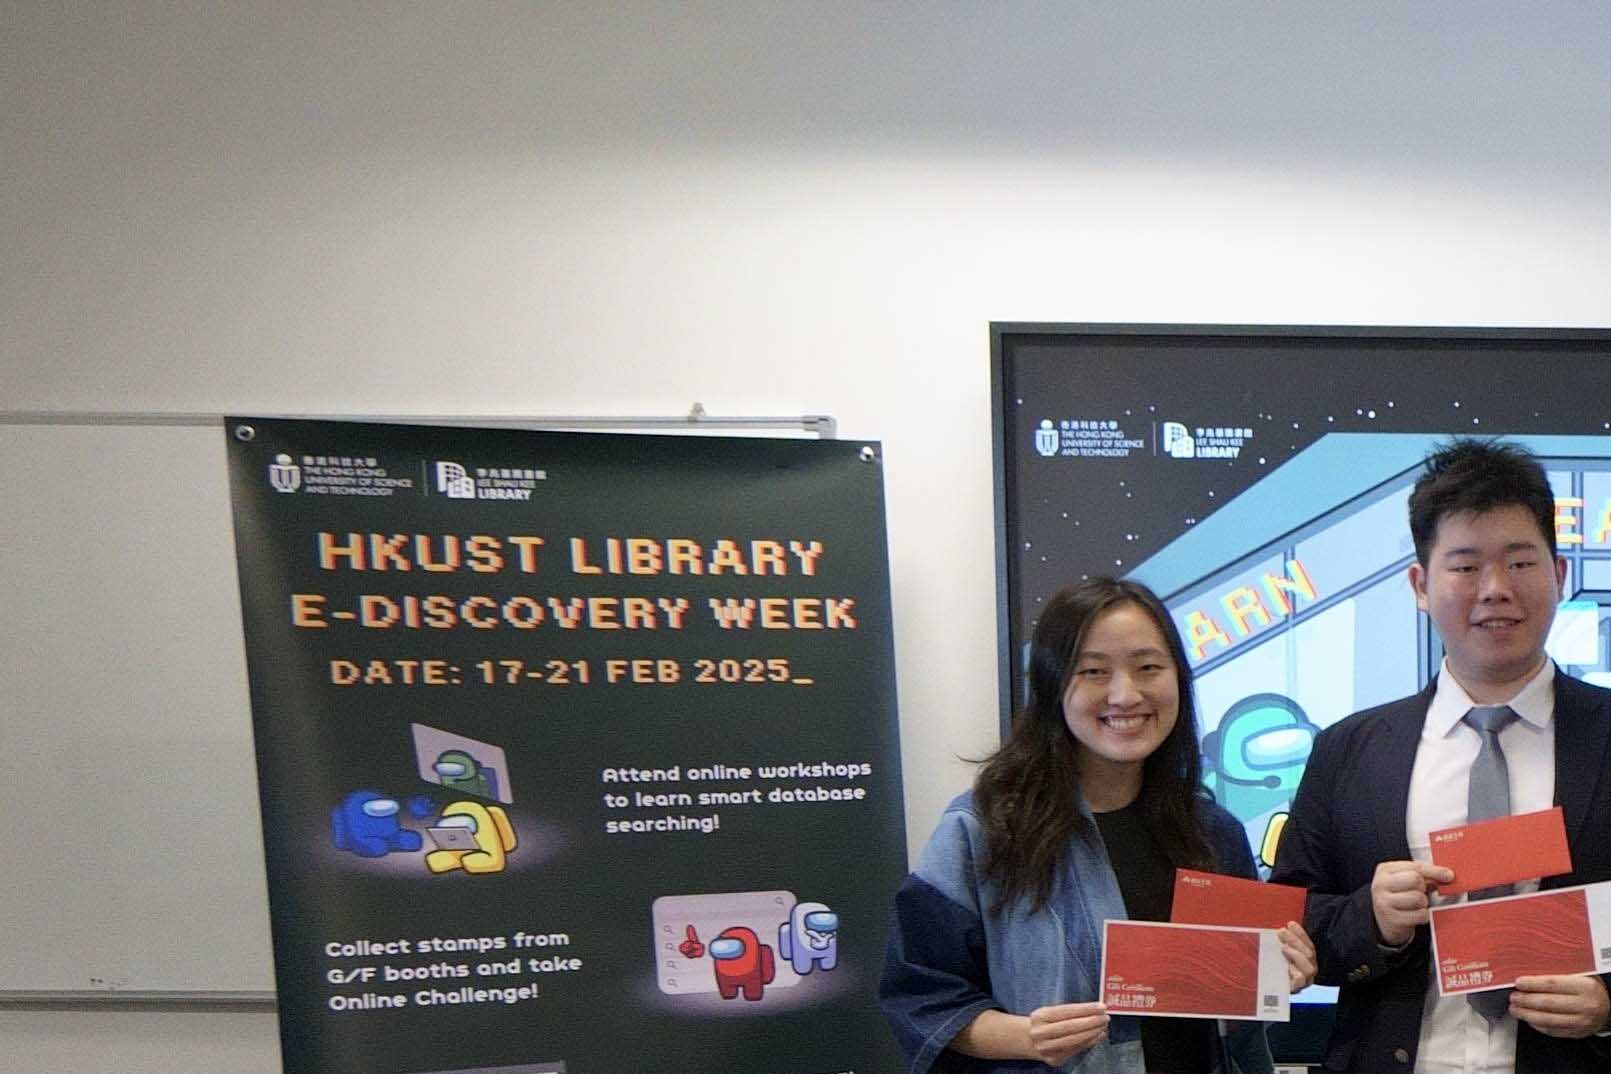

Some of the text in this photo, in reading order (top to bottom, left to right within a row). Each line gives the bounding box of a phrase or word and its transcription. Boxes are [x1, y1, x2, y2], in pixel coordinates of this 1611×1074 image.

[1196, 446, 1241, 458] LIBRARY
[477, 488, 533, 501] LIBRARY
[317, 532, 825, 577] HKUST LIBRARY
[291, 593, 858, 631] E-DISCOVERY WEEK
[1184, 560, 1318, 662] ARN
[330, 659, 462, 686] DATE:
[477, 659, 590, 685] 17-21
[606, 659, 680, 684] FEB
[602, 761, 872, 783] Attend online workshops
[604, 785, 866, 808] to learn smart database
[606, 814, 720, 835] searching!
[324, 931, 570, 958] Collect stamps from
[327, 955, 583, 985] G/F booths and take
[328, 983, 539, 1011] Online Challenge!
